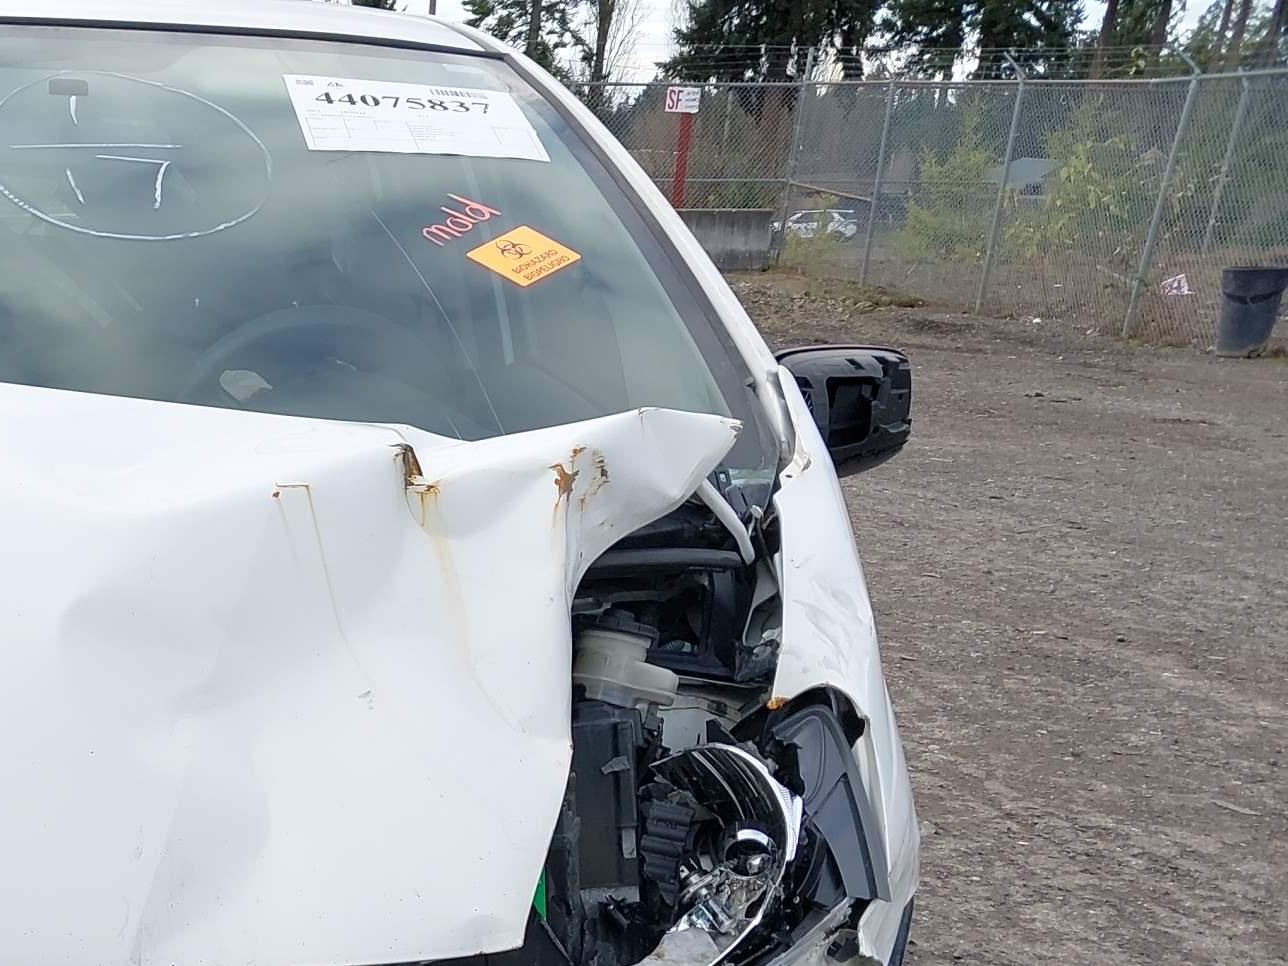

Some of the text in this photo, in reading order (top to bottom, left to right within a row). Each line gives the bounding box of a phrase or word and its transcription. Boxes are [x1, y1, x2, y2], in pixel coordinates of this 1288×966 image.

[314, 91, 490, 115] 44075837
[667, 89, 684, 110] SF
[422, 192, 503, 247] mold
[511, 249, 559, 274] BIOHAZARD
[523, 255, 571, 281] BIOPELIGRO
